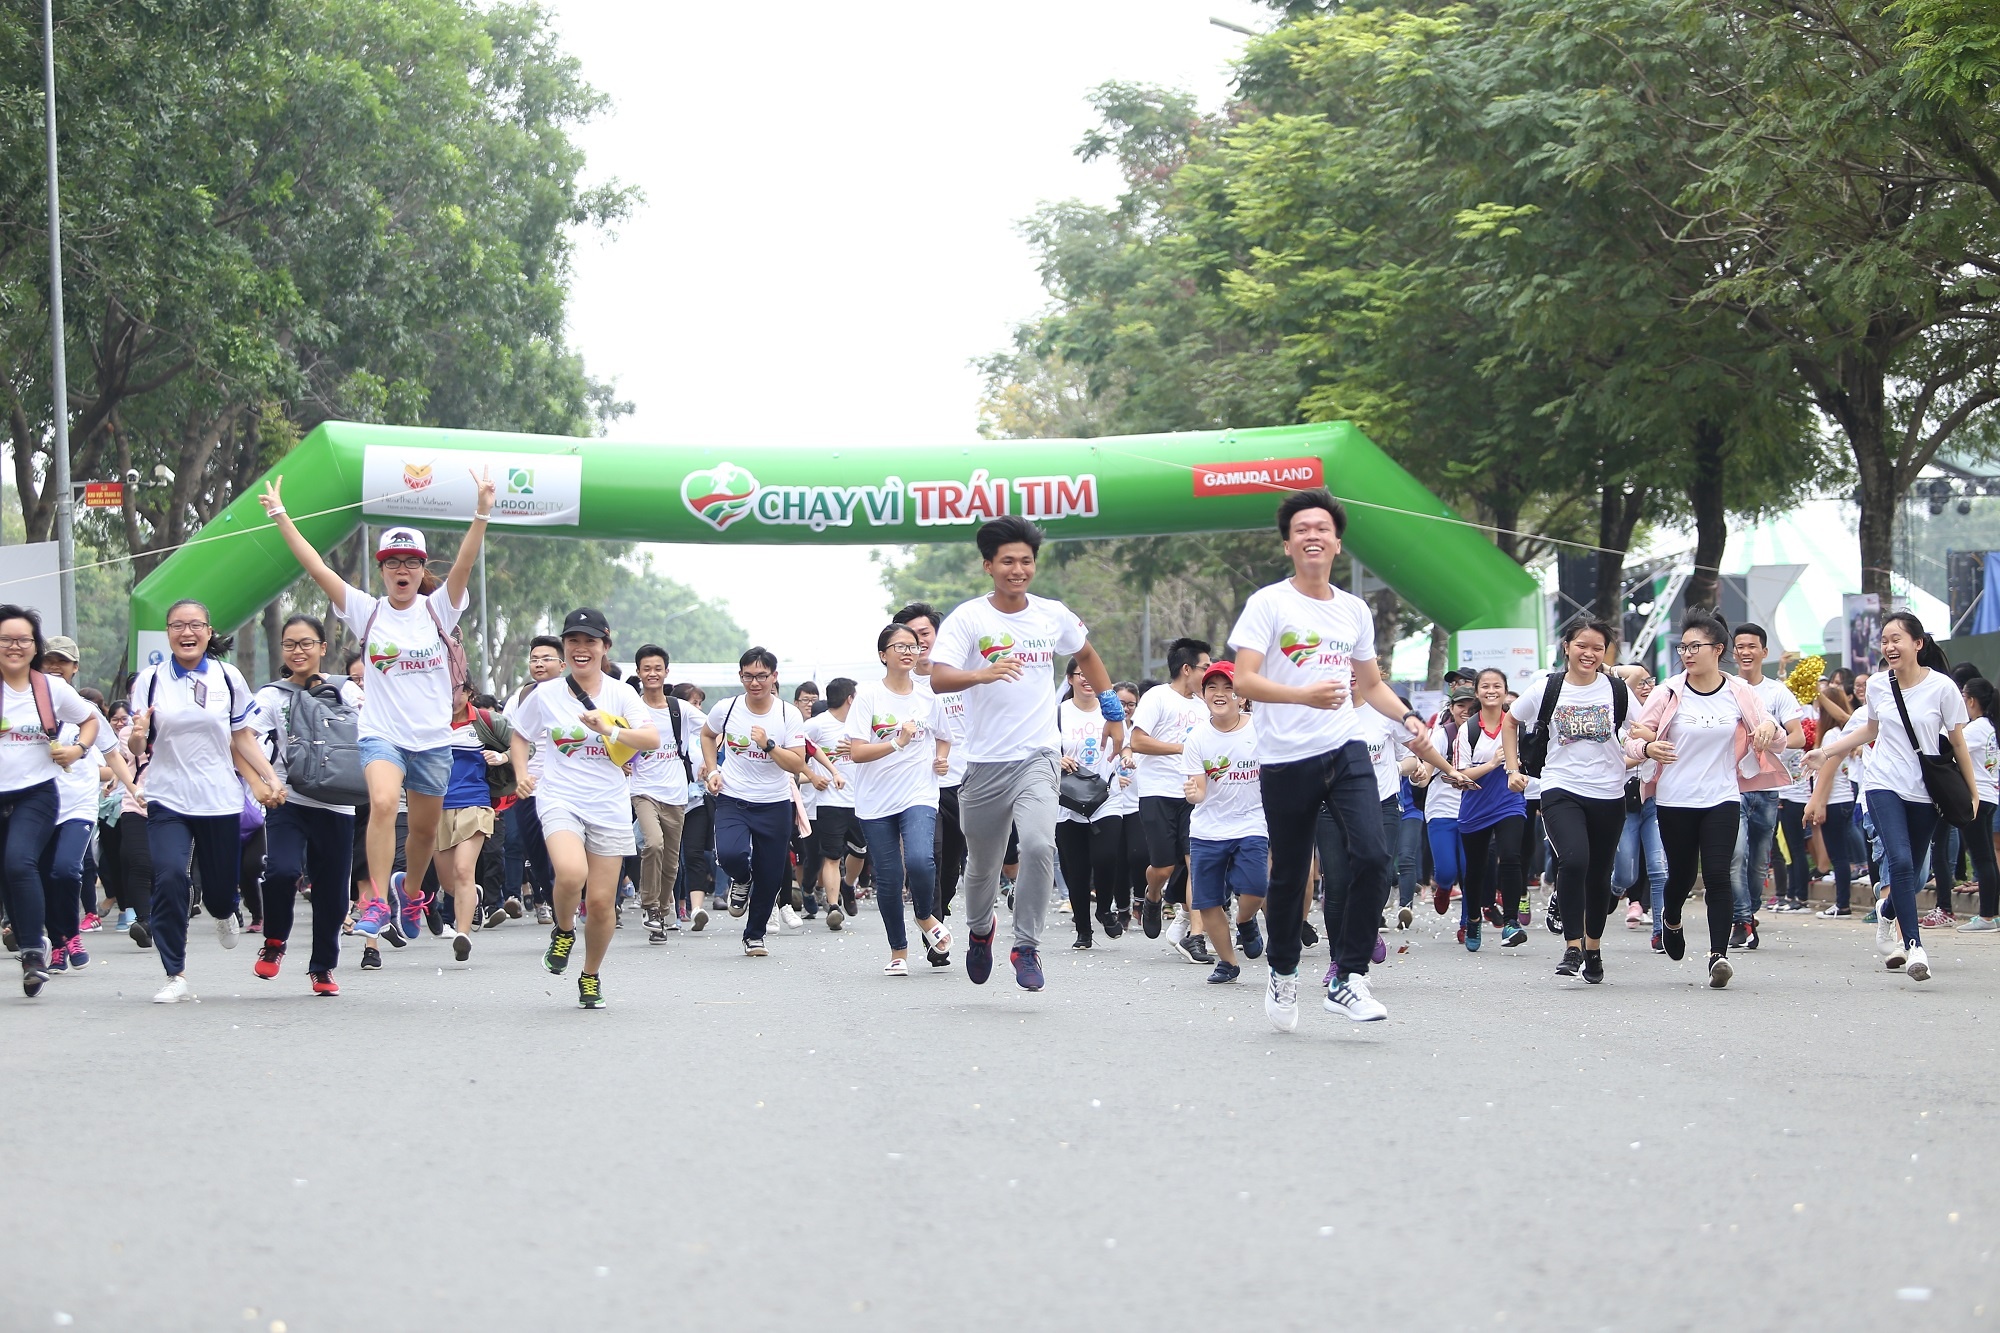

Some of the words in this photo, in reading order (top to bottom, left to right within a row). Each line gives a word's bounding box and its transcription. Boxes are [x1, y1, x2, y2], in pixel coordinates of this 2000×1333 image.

[1203, 469, 1271, 487] GAMUDA
[1273, 466, 1314, 482] LAND
[757, 490, 857, 528] CHẠY
[864, 481, 900, 521] VÌ
[912, 473, 1005, 520] TRÁI
[1018, 479, 1094, 516] TIM
[1569, 715, 1595, 723] DREAM
[1569, 721, 1596, 736] BIG
